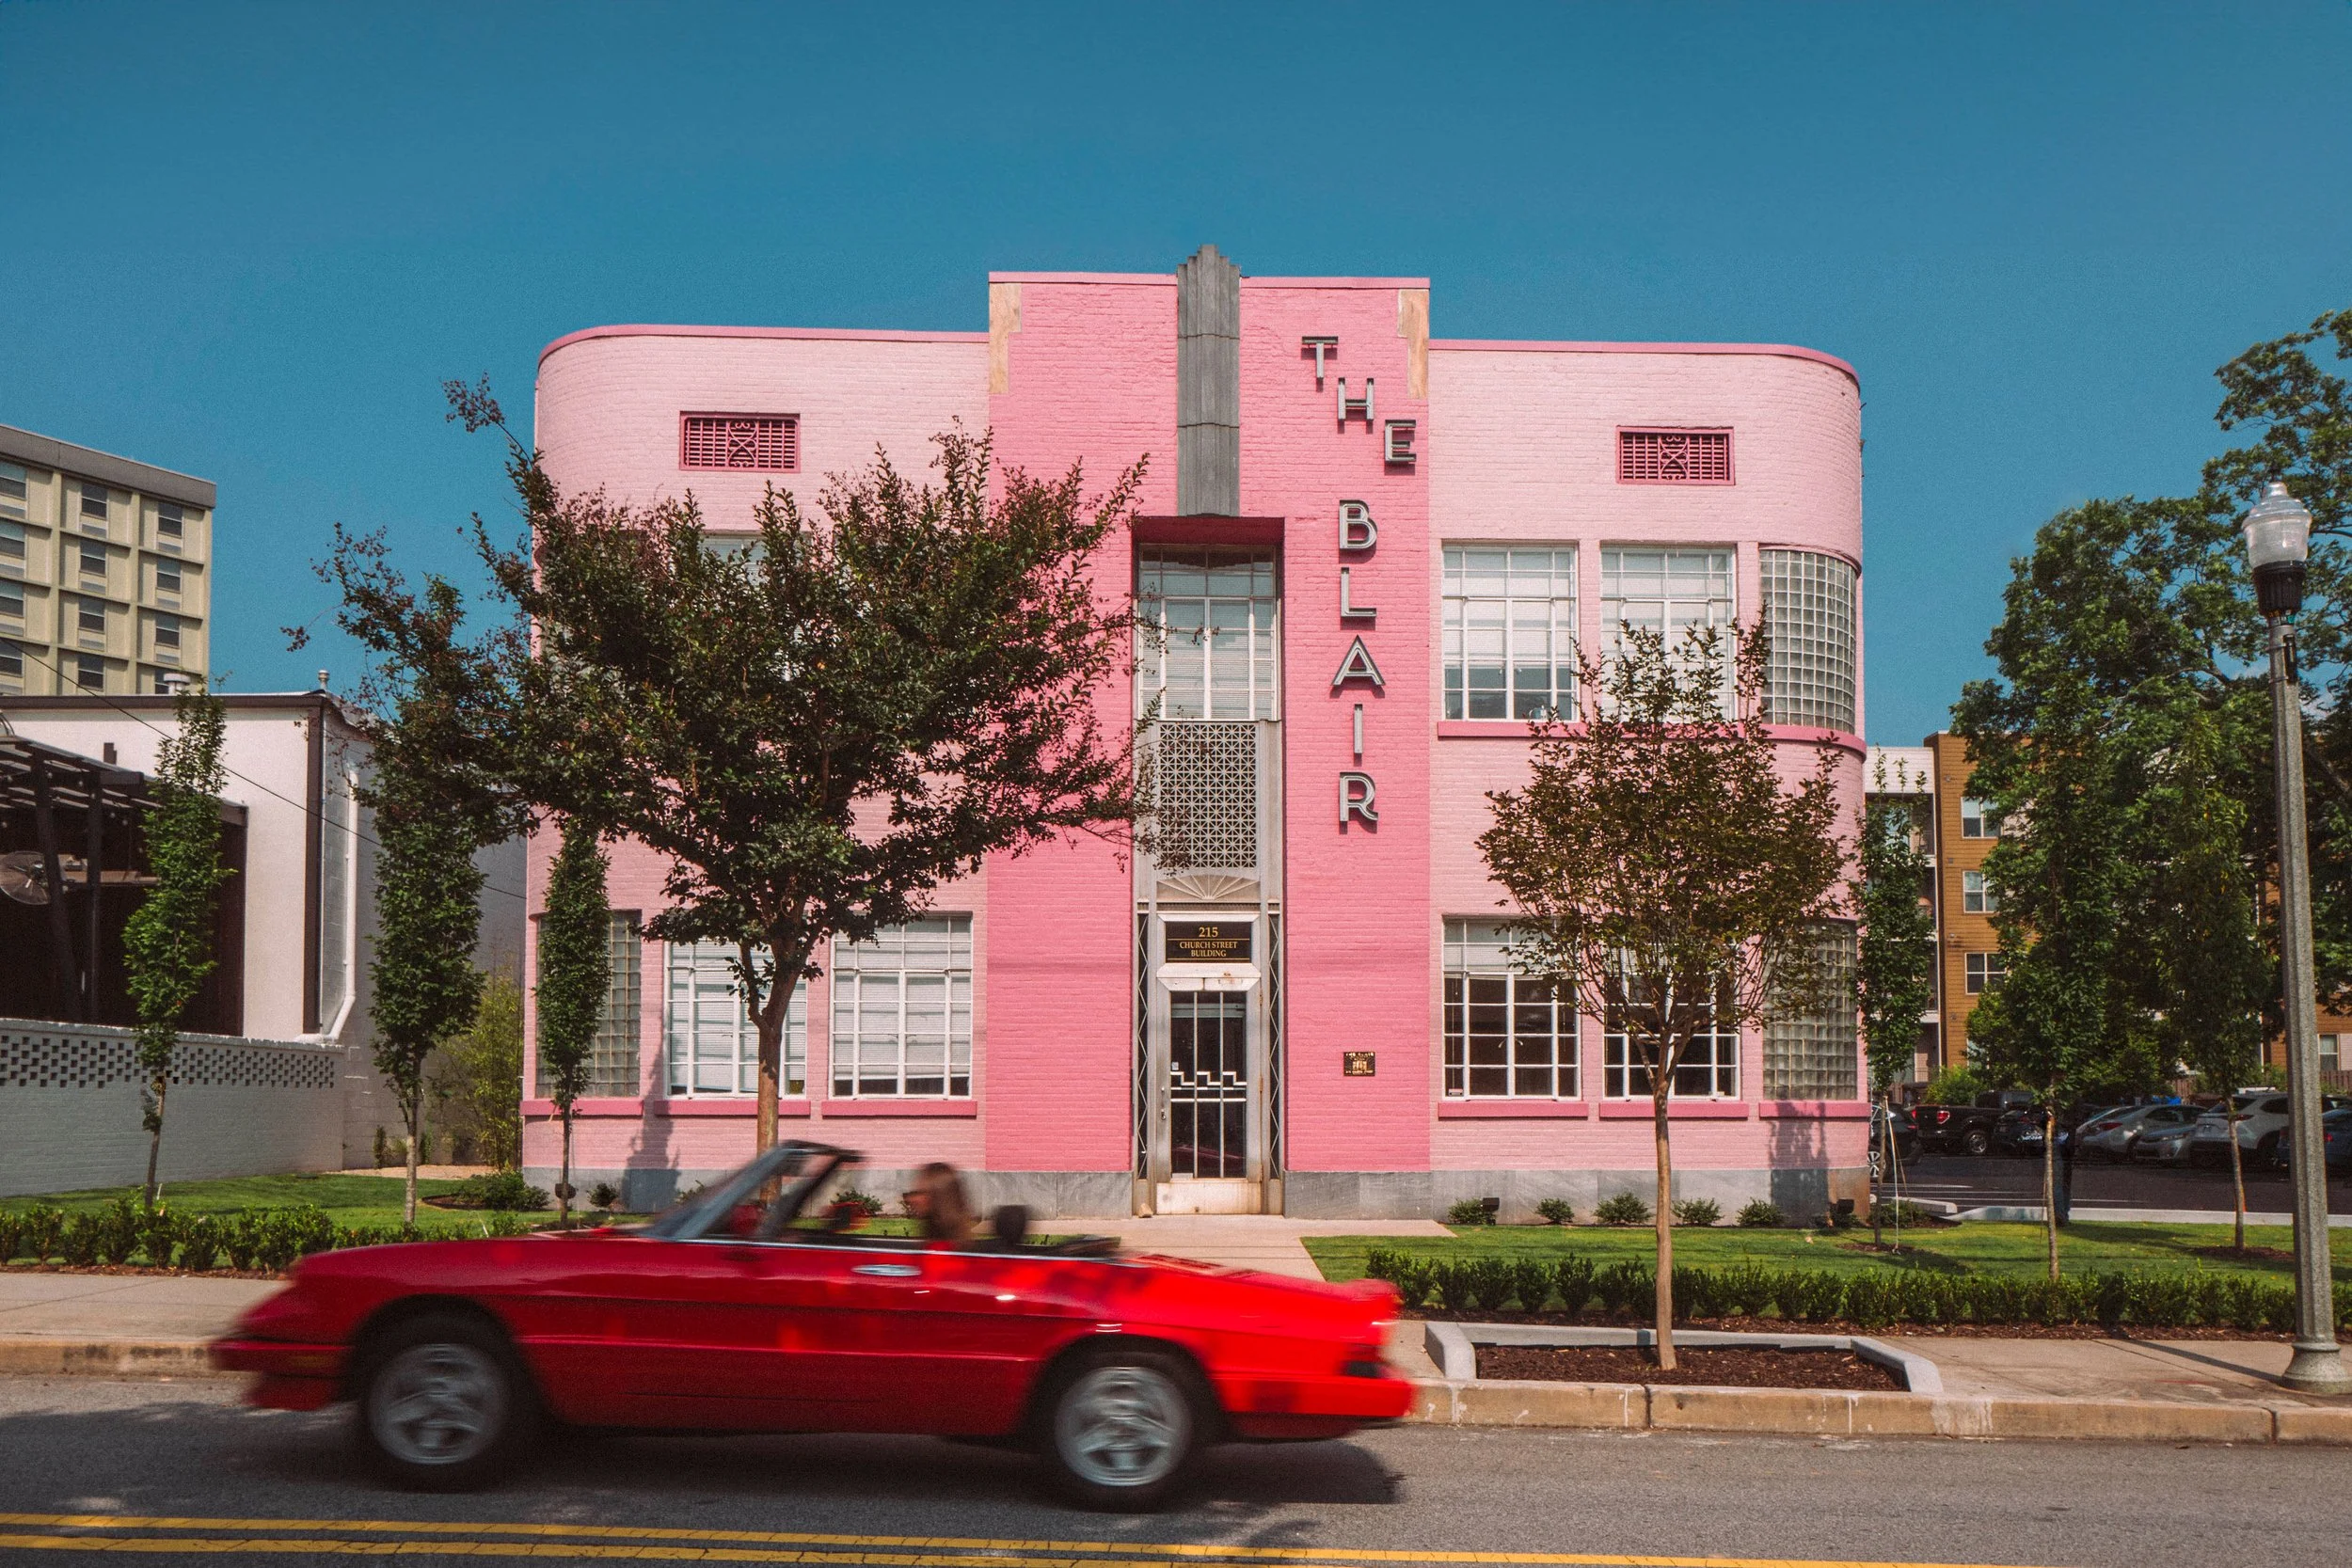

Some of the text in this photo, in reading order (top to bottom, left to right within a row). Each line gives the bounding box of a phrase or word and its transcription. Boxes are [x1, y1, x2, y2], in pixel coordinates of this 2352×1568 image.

[1302, 336, 1417, 823] THE BLAIR
[1199, 927, 1219, 937] 215
